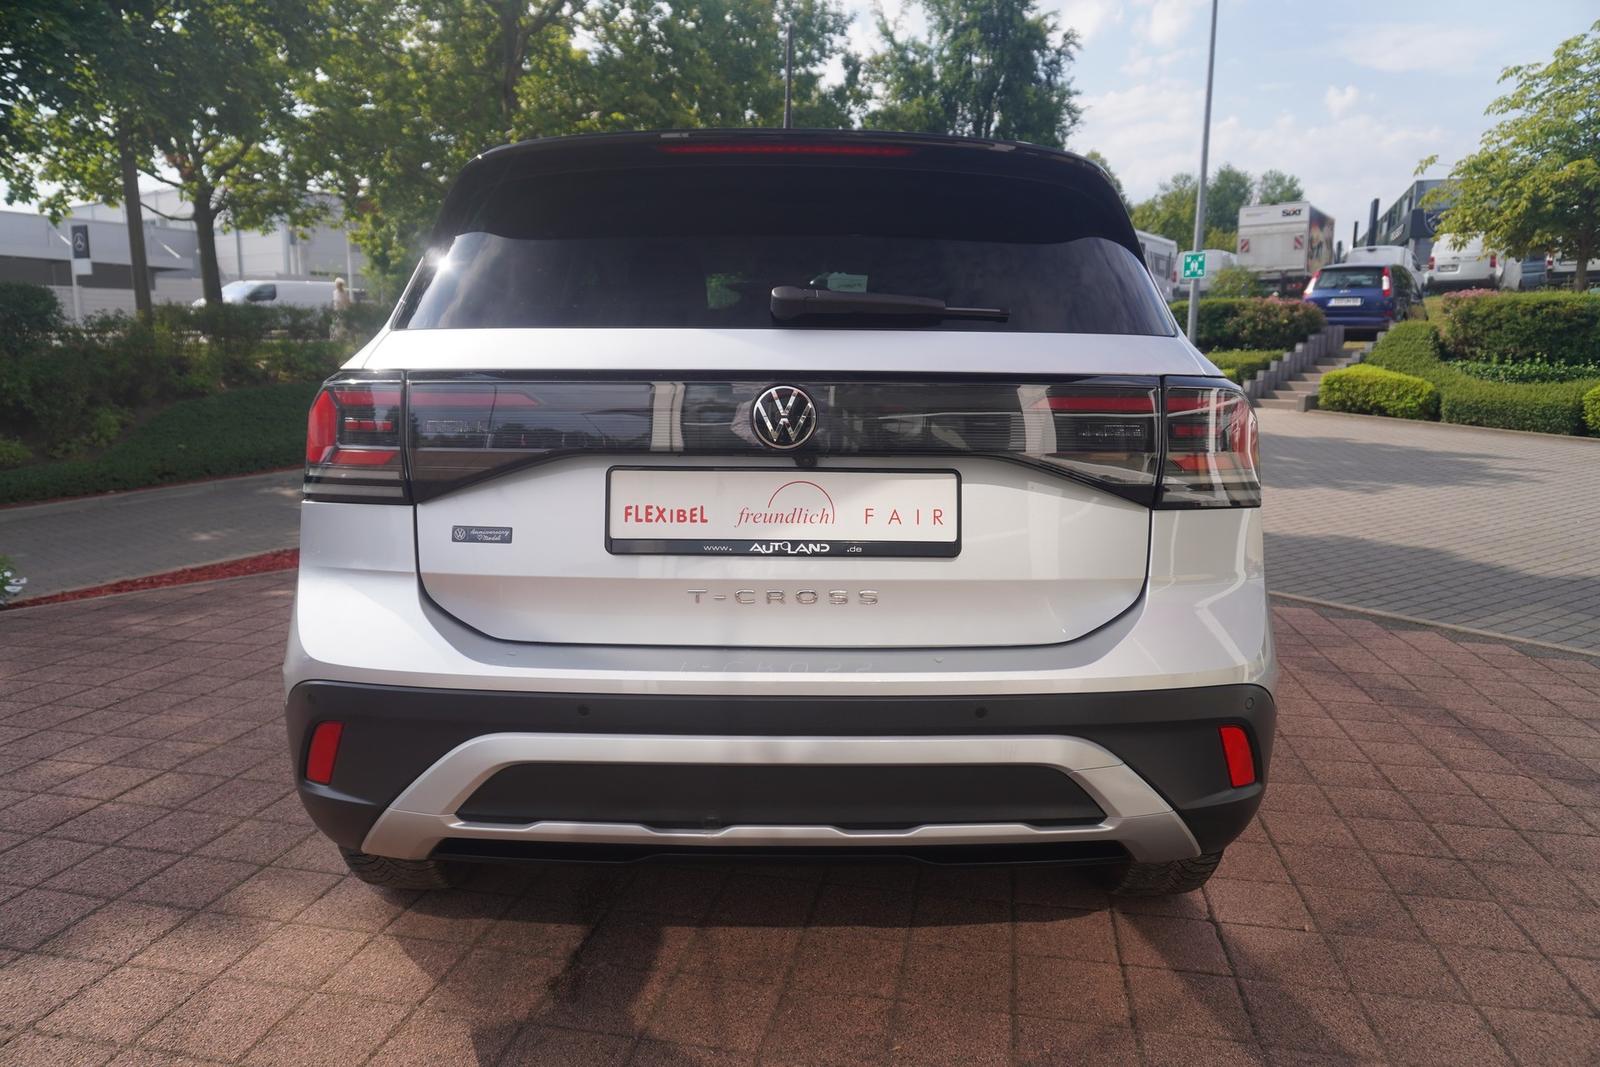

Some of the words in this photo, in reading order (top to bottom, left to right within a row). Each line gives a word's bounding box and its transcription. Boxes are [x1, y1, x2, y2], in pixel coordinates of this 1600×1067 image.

[624, 505, 708, 523] FLEXIBEL
[734, 507, 829, 527] freundlich
[864, 508, 943, 525] FAIR
[749, 541, 830, 554] AUTOLAND
[847, 545, 862, 553] .de
[687, 589, 878, 605] T-CROSS
